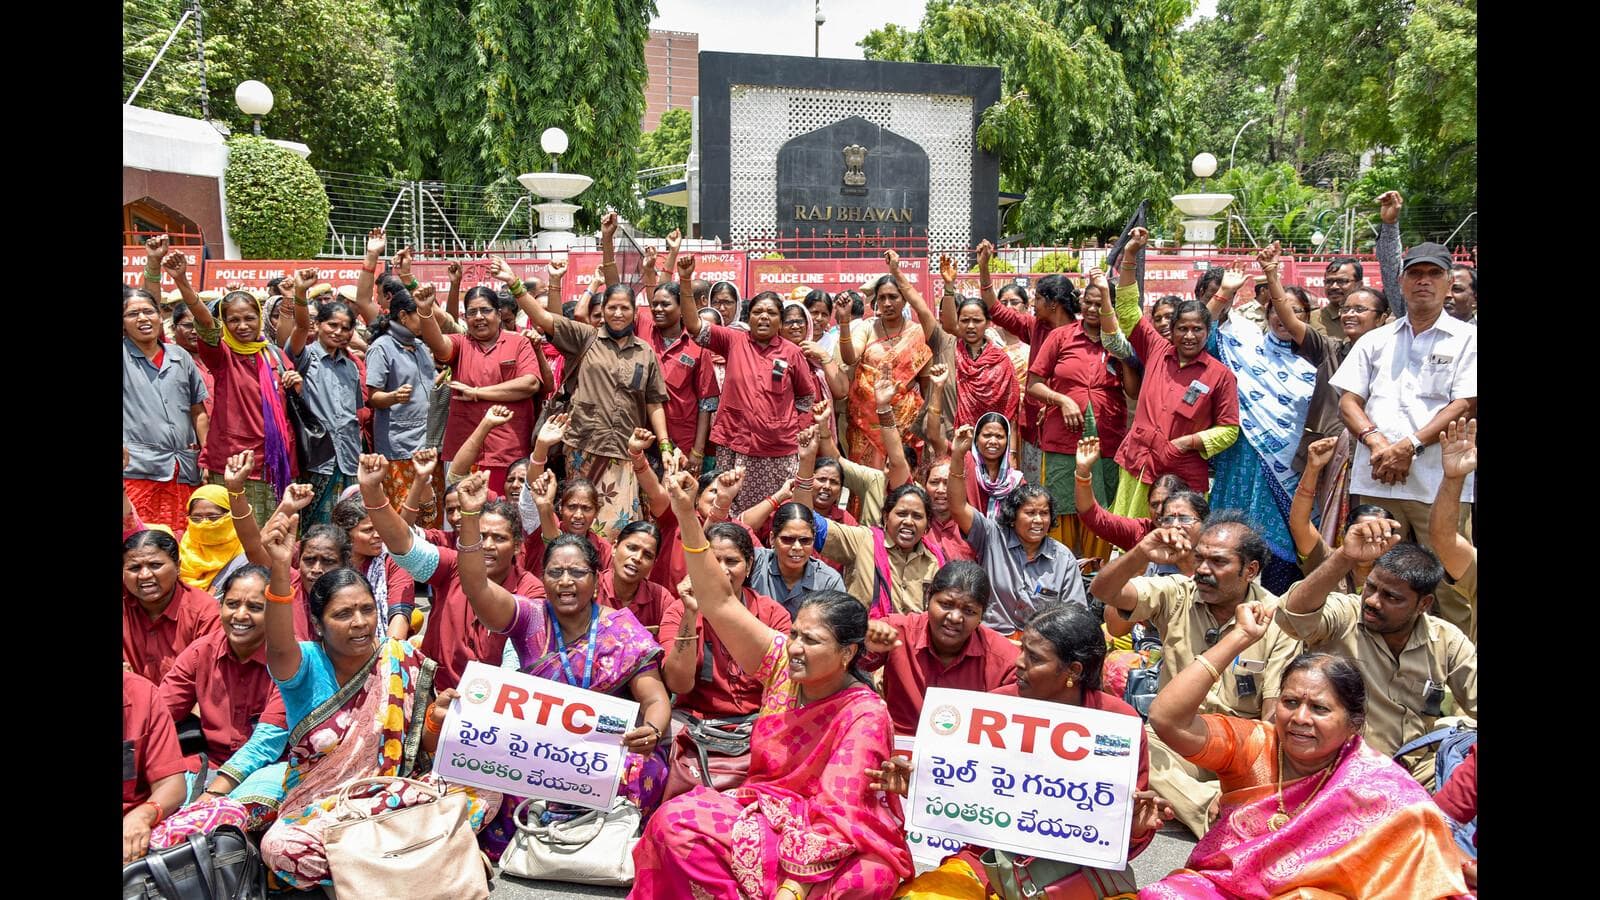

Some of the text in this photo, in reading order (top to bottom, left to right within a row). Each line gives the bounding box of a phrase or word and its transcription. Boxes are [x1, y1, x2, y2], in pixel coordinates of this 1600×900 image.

[794, 204, 914, 223] RAJ BHAVAN
[132, 256, 148, 265] NO
[215, 270, 257, 280] POLICE
[259, 270, 285, 280] LINE
[338, 270, 361, 280] CRO
[700, 271, 736, 282] CROSS
[760, 272, 799, 284] POLICE
[800, 273, 825, 284] LINE
[839, 273, 855, 283] DO
[856, 273, 874, 283] NO
[1144, 269, 1162, 280] ICE
[1164, 269, 1188, 280] LINE
[493, 684, 596, 735] RTC
[967, 708, 1091, 761] RTC
[451, 752, 523, 781] సంతకం
[533, 741, 609, 775] గవర్నర్
[1022, 774, 1115, 812] గవర్నర్
[925, 796, 1110, 847] సంతకం చేయాలి..
